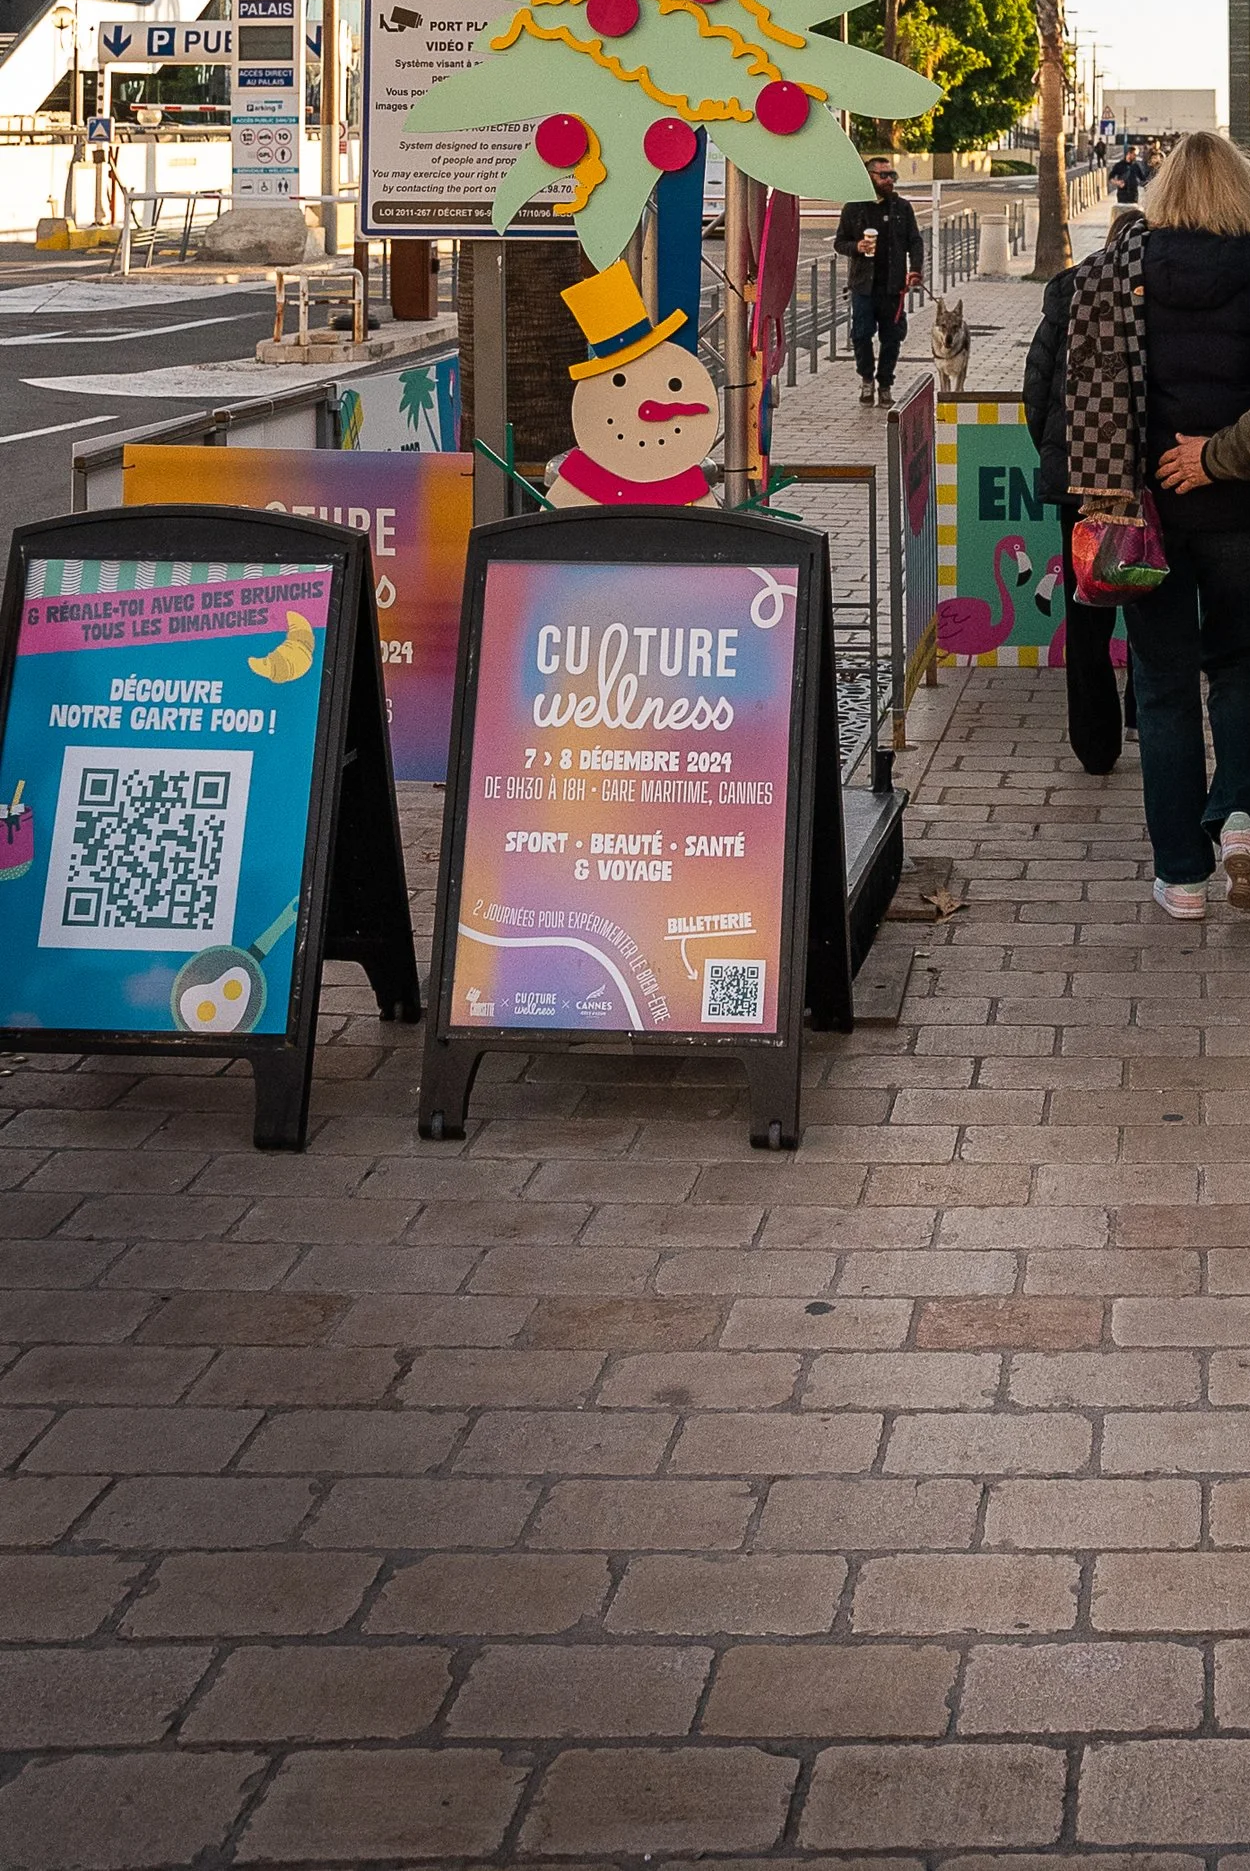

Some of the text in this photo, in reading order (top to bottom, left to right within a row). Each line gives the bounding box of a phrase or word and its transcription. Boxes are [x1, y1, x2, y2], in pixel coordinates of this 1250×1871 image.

[240, 3, 292, 15] PALAIS
[429, 21, 463, 32] PORT
[152, 30, 170, 53] P
[426, 39, 464, 52] VIDÉO
[395, 59, 434, 70] Système
[436, 59, 464, 68] visant
[466, 59, 472, 68] à
[386, 87, 408, 96] Vous
[522, 124, 536, 133] BY
[399, 141, 433, 150] System
[436, 142, 477, 153] designed
[480, 142, 489, 150] to
[431, 156, 493, 166] of people and
[372, 170, 499, 180] You may exercice your right
[382, 184, 394, 194] by
[396, 184, 444, 194] contacting
[446, 184, 461, 193] the
[464, 185, 482, 194] port
[379, 208, 394, 217] LOI
[395, 208, 432, 217] 2011-267
[438, 207, 472, 217] DÉCRET
[28, 608, 39, 625] &
[152, 593, 195, 613] AVEC
[202, 590, 234, 610] DES
[240, 581, 324, 604] BRUNCHS
[81, 608, 269, 642] TOUS LES DIMANCHES
[110, 674, 223, 704] DÉCOUVRE
[533, 668, 734, 731] wellness
[49, 704, 122, 729] NOTRE
[130, 707, 202, 731] CARTE
[524, 745, 732, 773] 7 8 DÉCEMBRE 2024
[484, 774, 773, 806] DE 9H30 À 18H GARE MARITIME, CANNES
[505, 830, 745, 857] SPORT BEAUTÉ SANTÉ
[574, 859, 673, 882] & VOYAGE
[667, 912, 752, 934] BILLETTERIE
[473, 899, 671, 1024] 2 JOURNÉES POUR EXPÉRIMENTER LE BIEN-ÊTRE
[576, 1000, 612, 1011] CANNES
